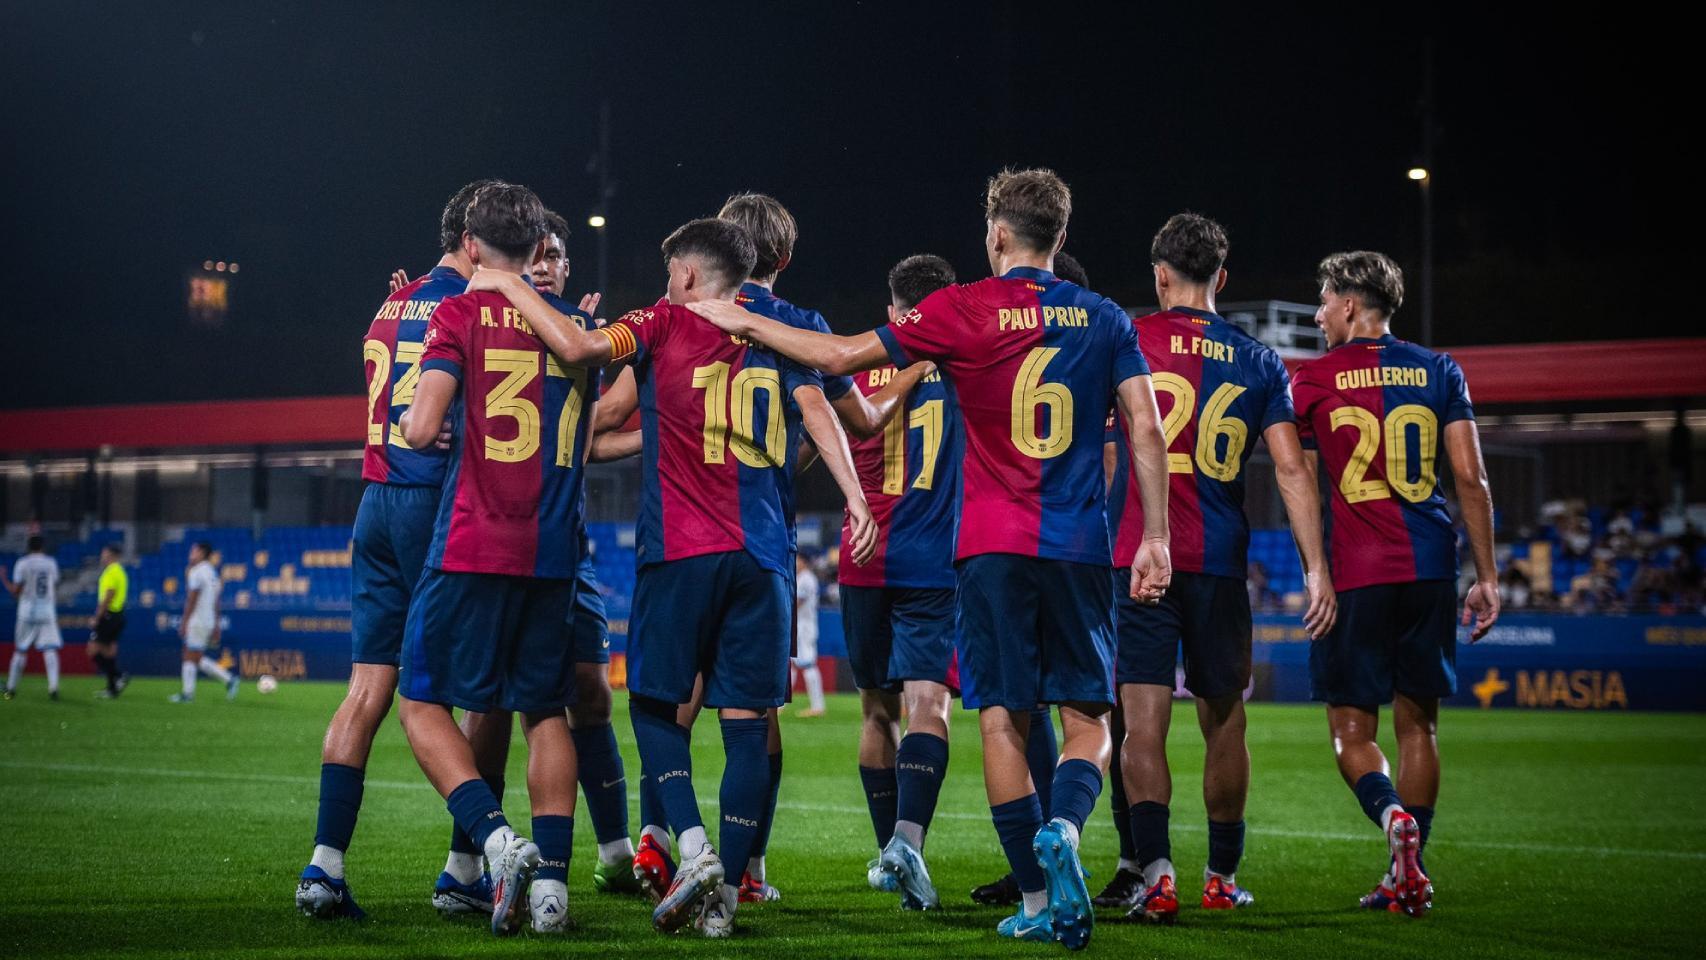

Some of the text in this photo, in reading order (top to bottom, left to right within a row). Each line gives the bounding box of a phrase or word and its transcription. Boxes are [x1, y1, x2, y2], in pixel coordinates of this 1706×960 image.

[401, 300, 441, 320] OLME
[480, 306, 498, 327] A.
[998, 306, 1089, 331] PAU PRIM
[1170, 335, 1234, 363] H. FORT
[1335, 366, 1428, 390] GUILLERMO
[485, 348, 588, 468] 37
[691, 360, 787, 468] 10
[1011, 346, 1074, 459] 6
[1150, 371, 1248, 482] 26
[1329, 404, 1438, 504] 20
